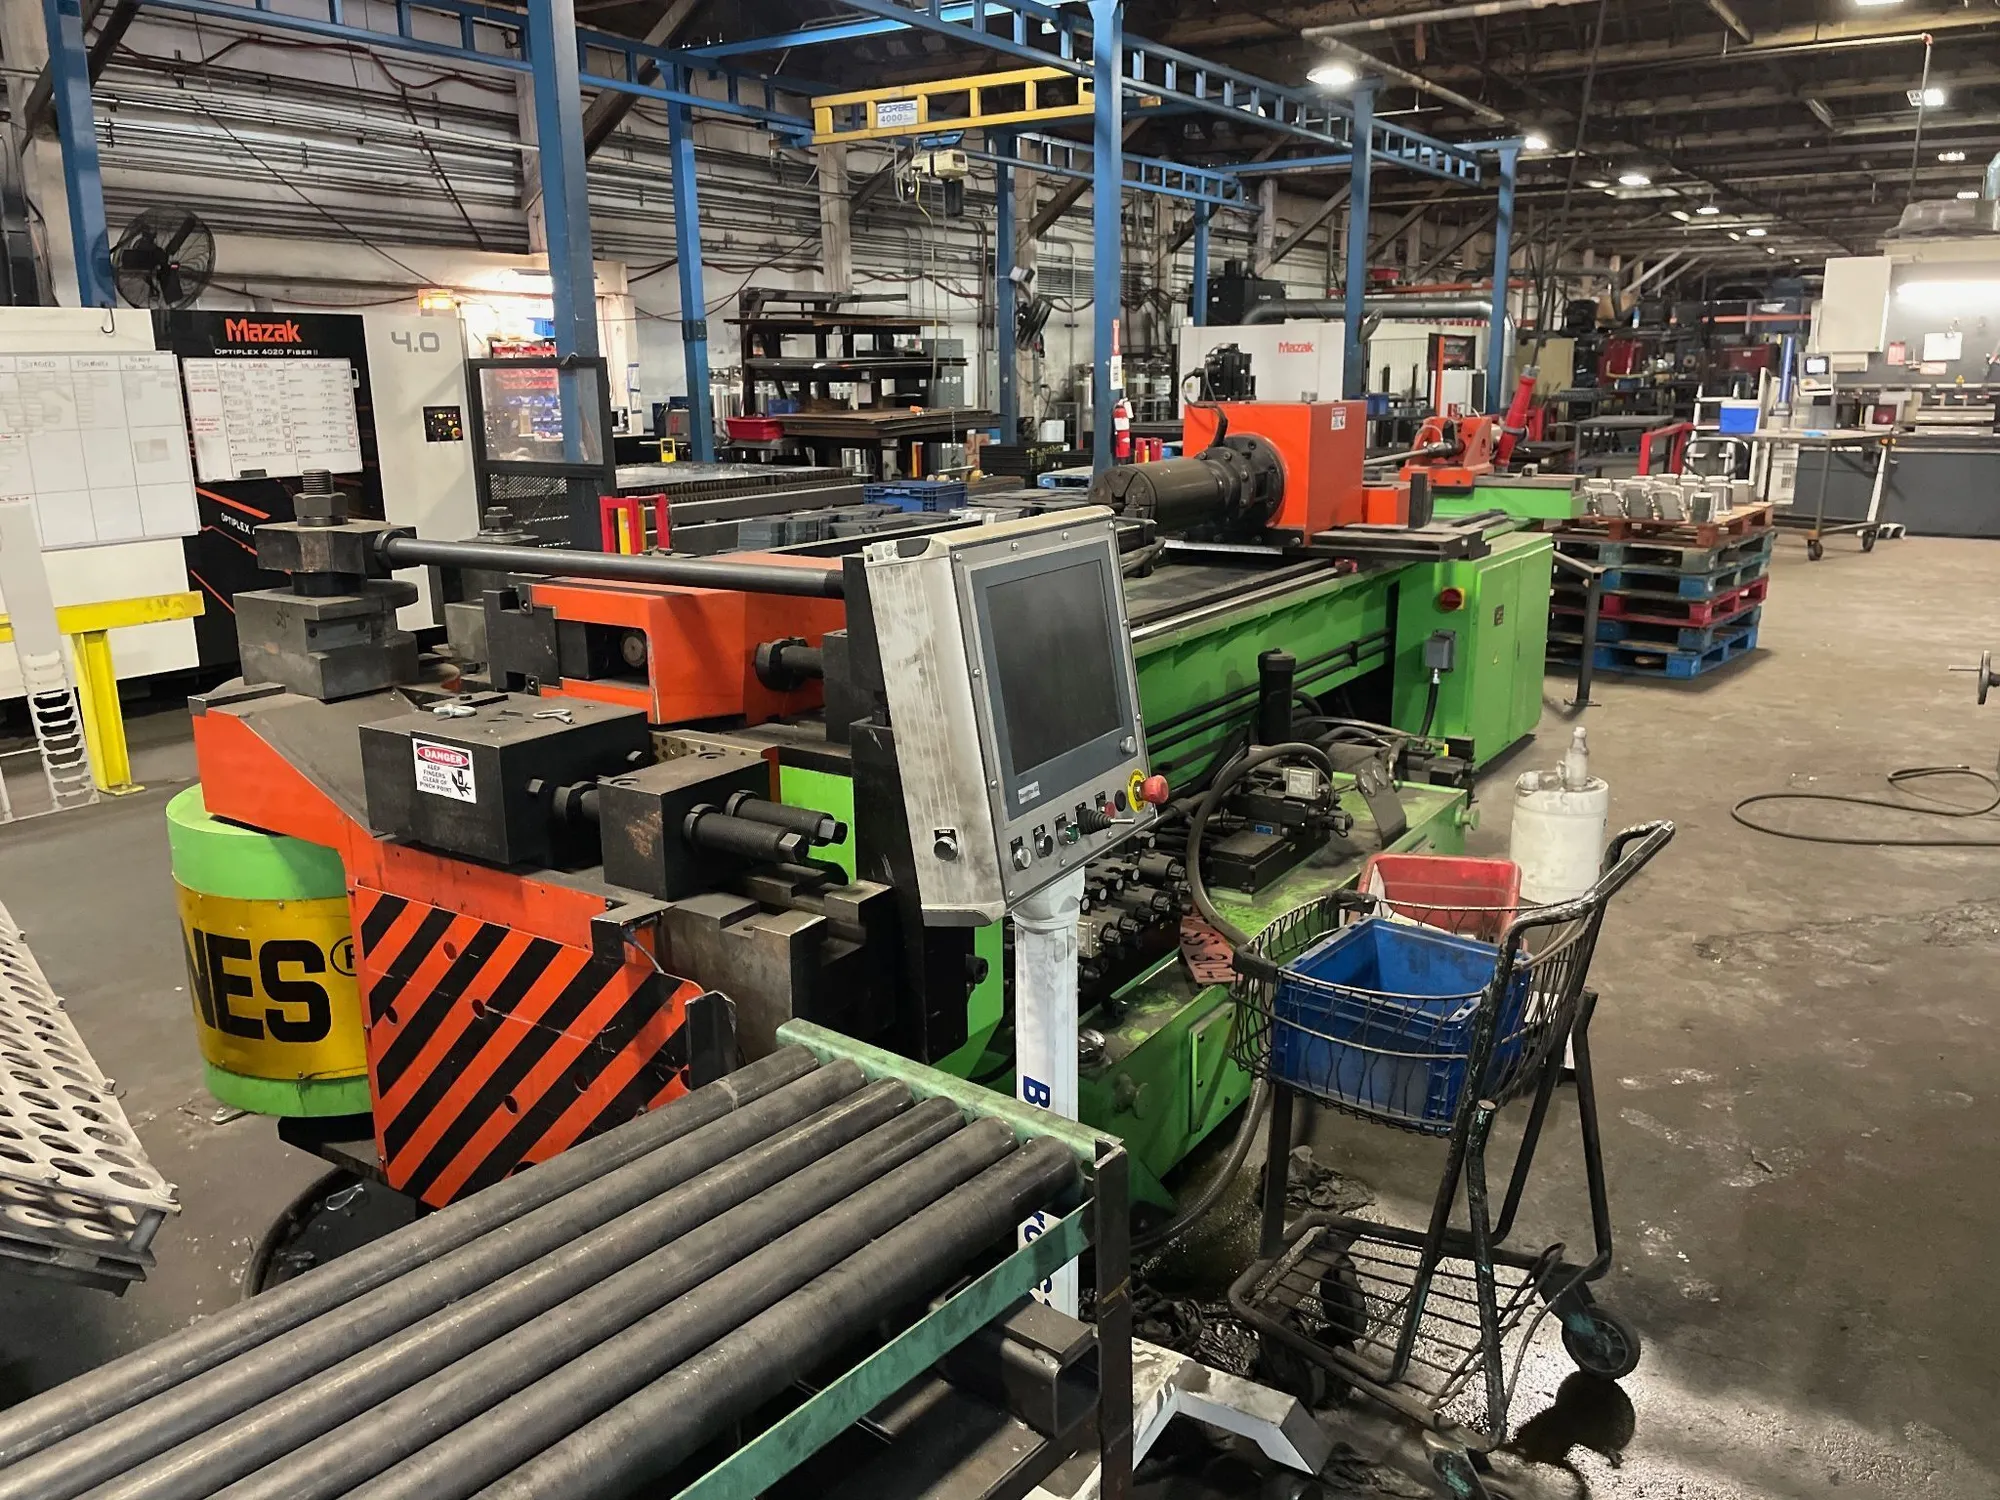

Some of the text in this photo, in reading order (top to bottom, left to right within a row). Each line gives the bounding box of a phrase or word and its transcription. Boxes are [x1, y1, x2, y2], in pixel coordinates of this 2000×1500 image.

[878, 103, 917, 114] GORBEL
[880, 114, 903, 122] 4000
[225, 318, 302, 343] Mazak
[390, 331, 440, 353] 4.0
[1278, 341, 1314, 353] Mazak
[261, 348, 284, 356] 4020
[424, 748, 463, 765] DANGER
[423, 769, 446, 779] FINGERS
[422, 776, 440, 784] CLEAR
[419, 781, 452, 793] PINCH POINT
